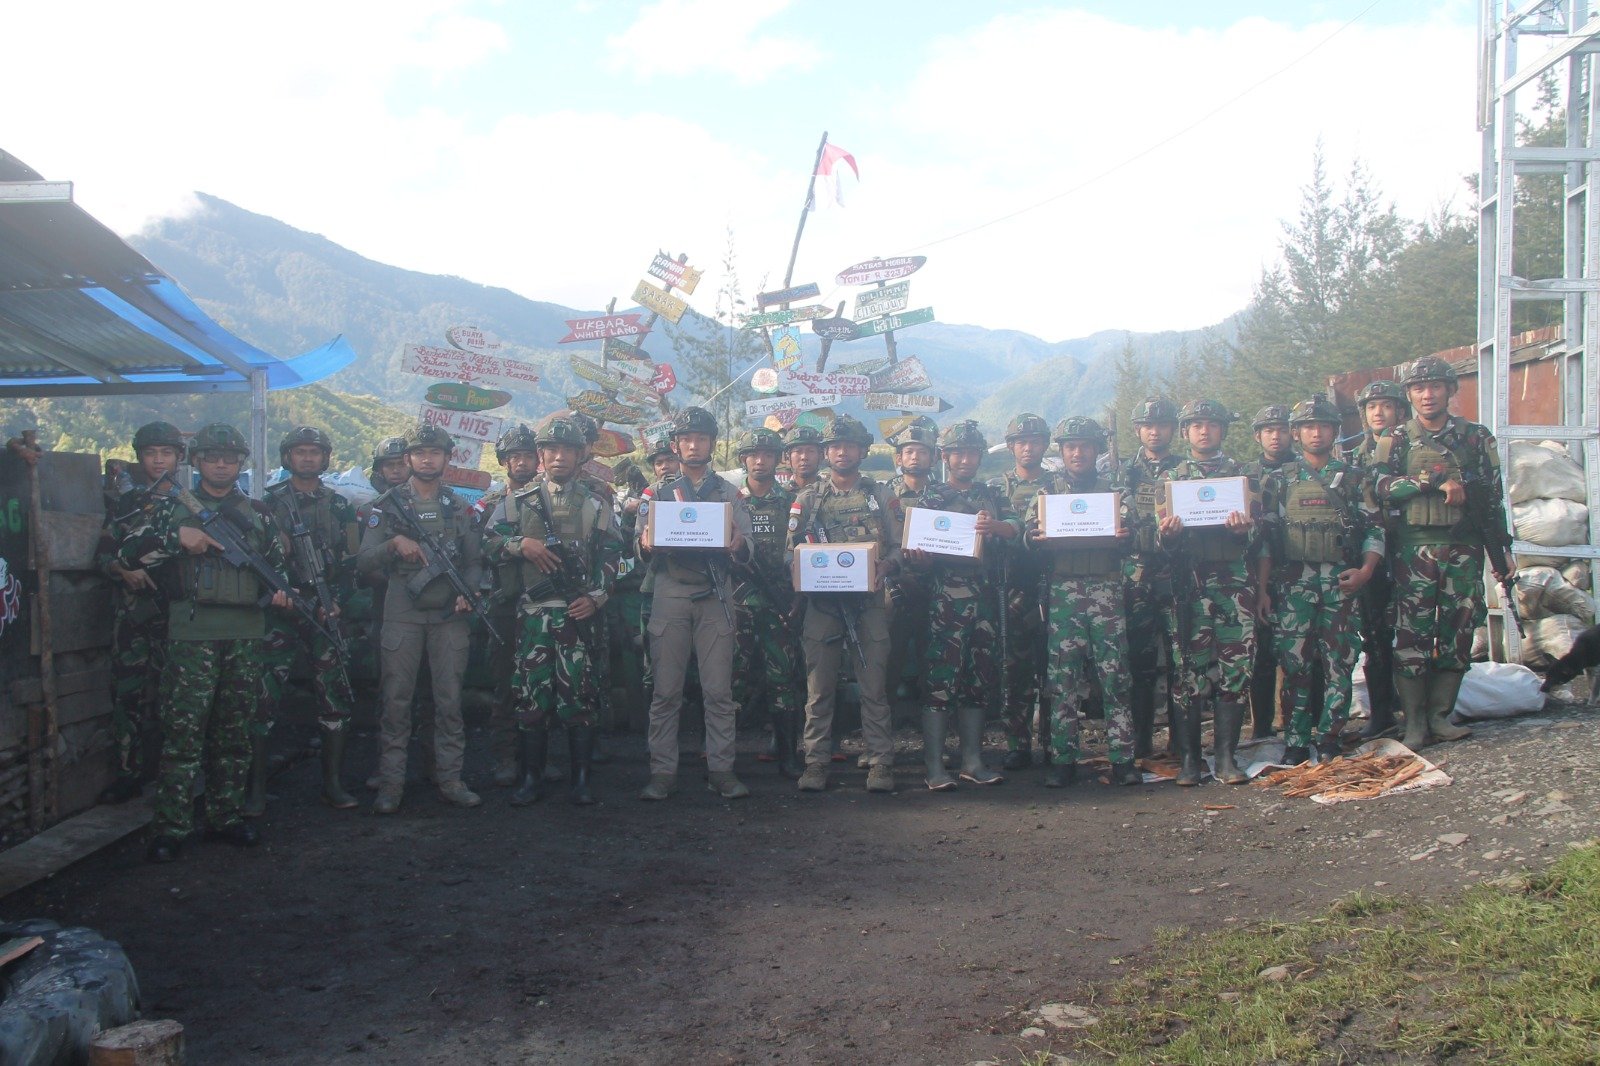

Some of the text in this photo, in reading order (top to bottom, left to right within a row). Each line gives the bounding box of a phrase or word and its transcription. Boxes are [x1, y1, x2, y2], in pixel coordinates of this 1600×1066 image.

[852, 257, 913, 271] SATGAS MOBILE
[648, 264, 688, 287] MINANG
[841, 272, 871, 284] YONIF
[576, 317, 629, 331] LIKBAR
[574, 325, 639, 340] WHITE LAND
[825, 373, 870, 386] Borneo
[801, 396, 818, 406] AIR
[457, 416, 494, 437] HITS
